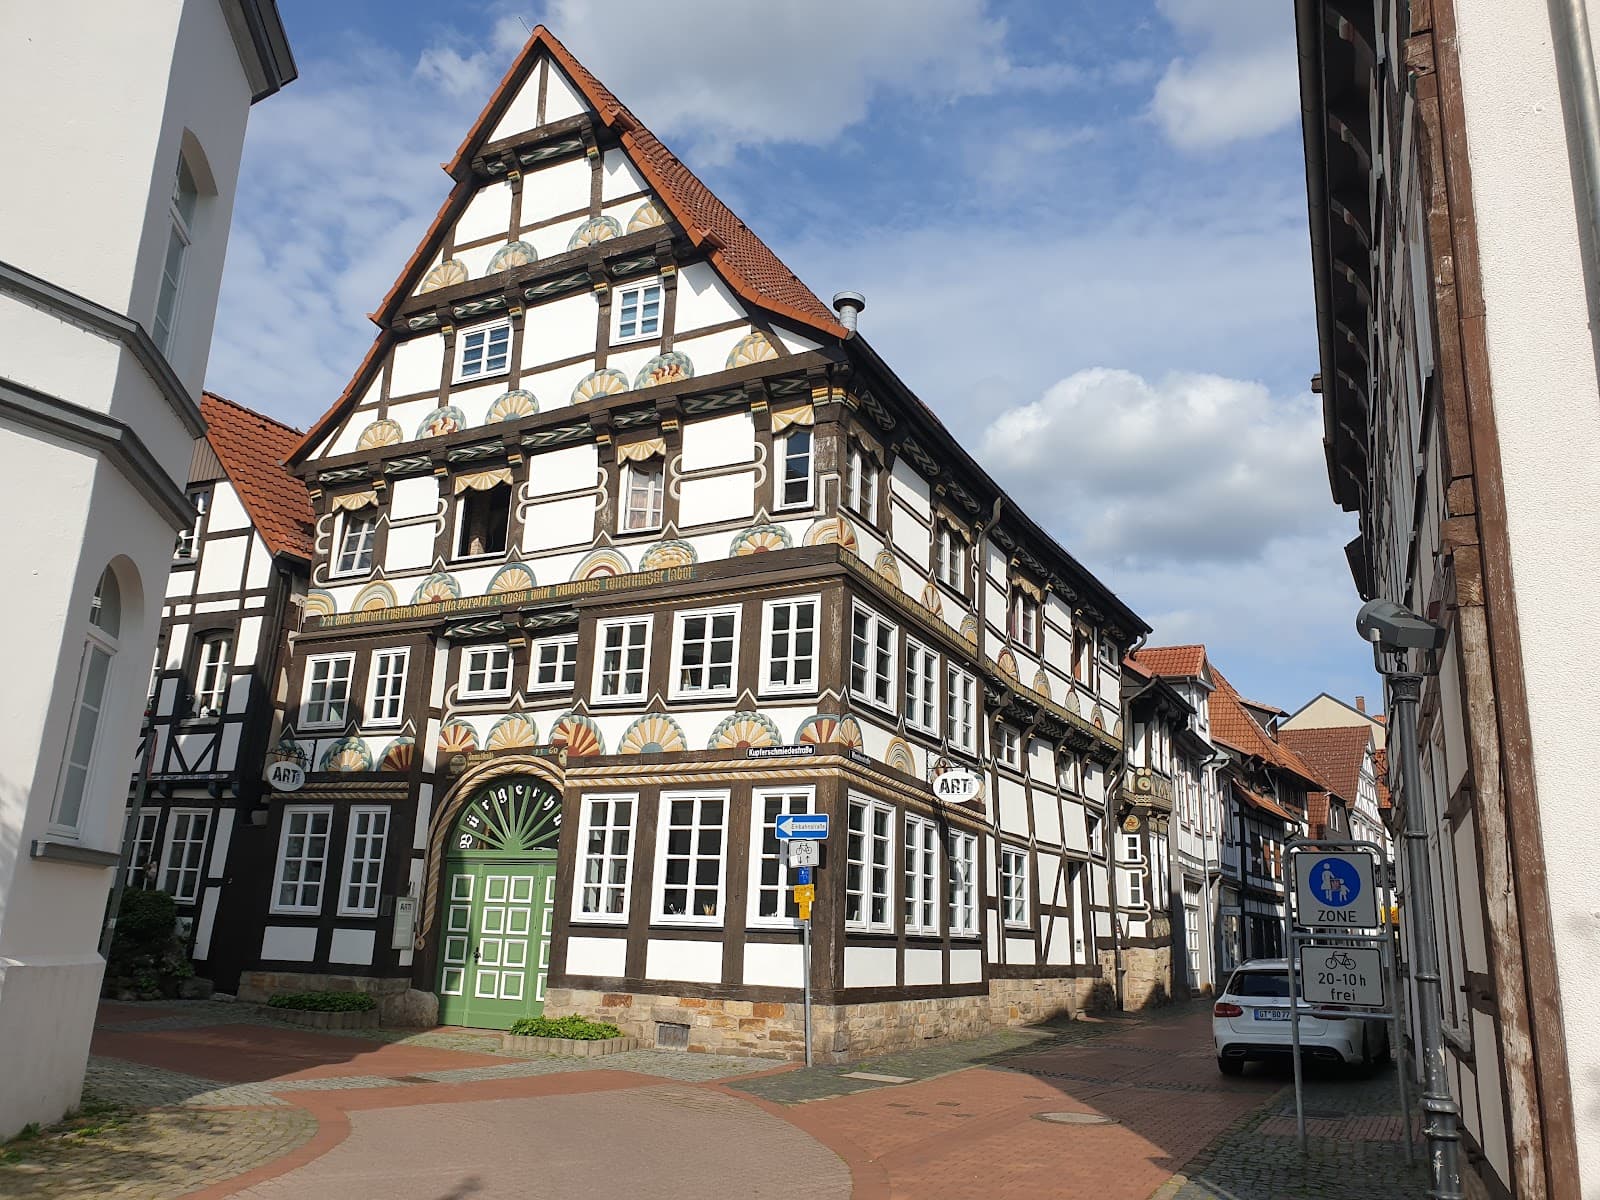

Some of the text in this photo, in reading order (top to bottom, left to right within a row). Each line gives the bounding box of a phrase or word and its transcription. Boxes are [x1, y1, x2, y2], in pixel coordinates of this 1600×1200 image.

[748, 746, 813, 758] Kupferschmiedestraße
[272, 766, 297, 783] ART
[938, 778, 969, 794] ART
[1318, 910, 1358, 923] ZONE
[1318, 972, 1367, 987] 20-10 h
[1330, 988, 1357, 1002] frei
